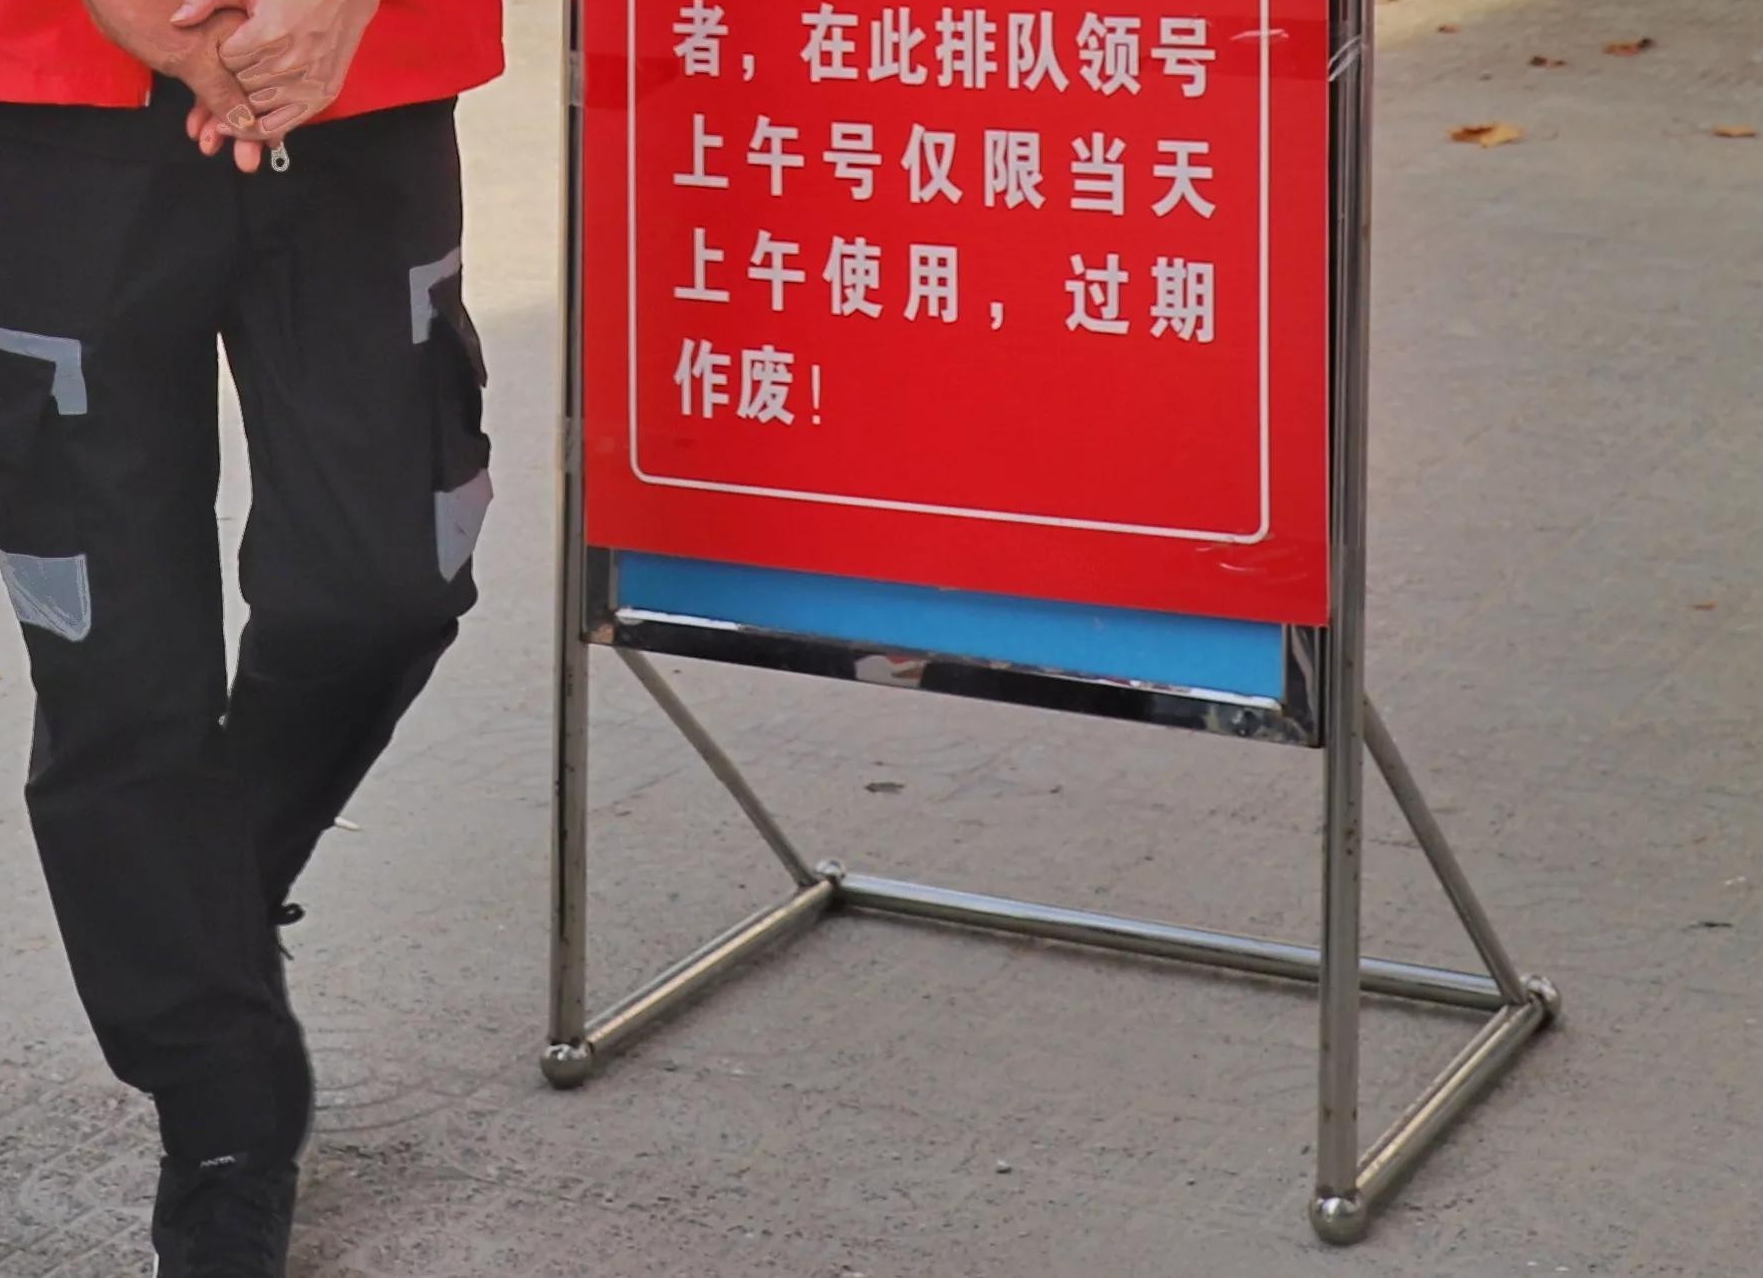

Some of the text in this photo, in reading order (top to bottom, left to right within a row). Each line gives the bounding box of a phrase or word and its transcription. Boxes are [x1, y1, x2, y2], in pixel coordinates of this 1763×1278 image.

[674, 0, 1215, 97] 者，在此排队领号
[675, 115, 1215, 218] 上午号仅限当天
[675, 229, 1214, 343] 上午使用，过期
